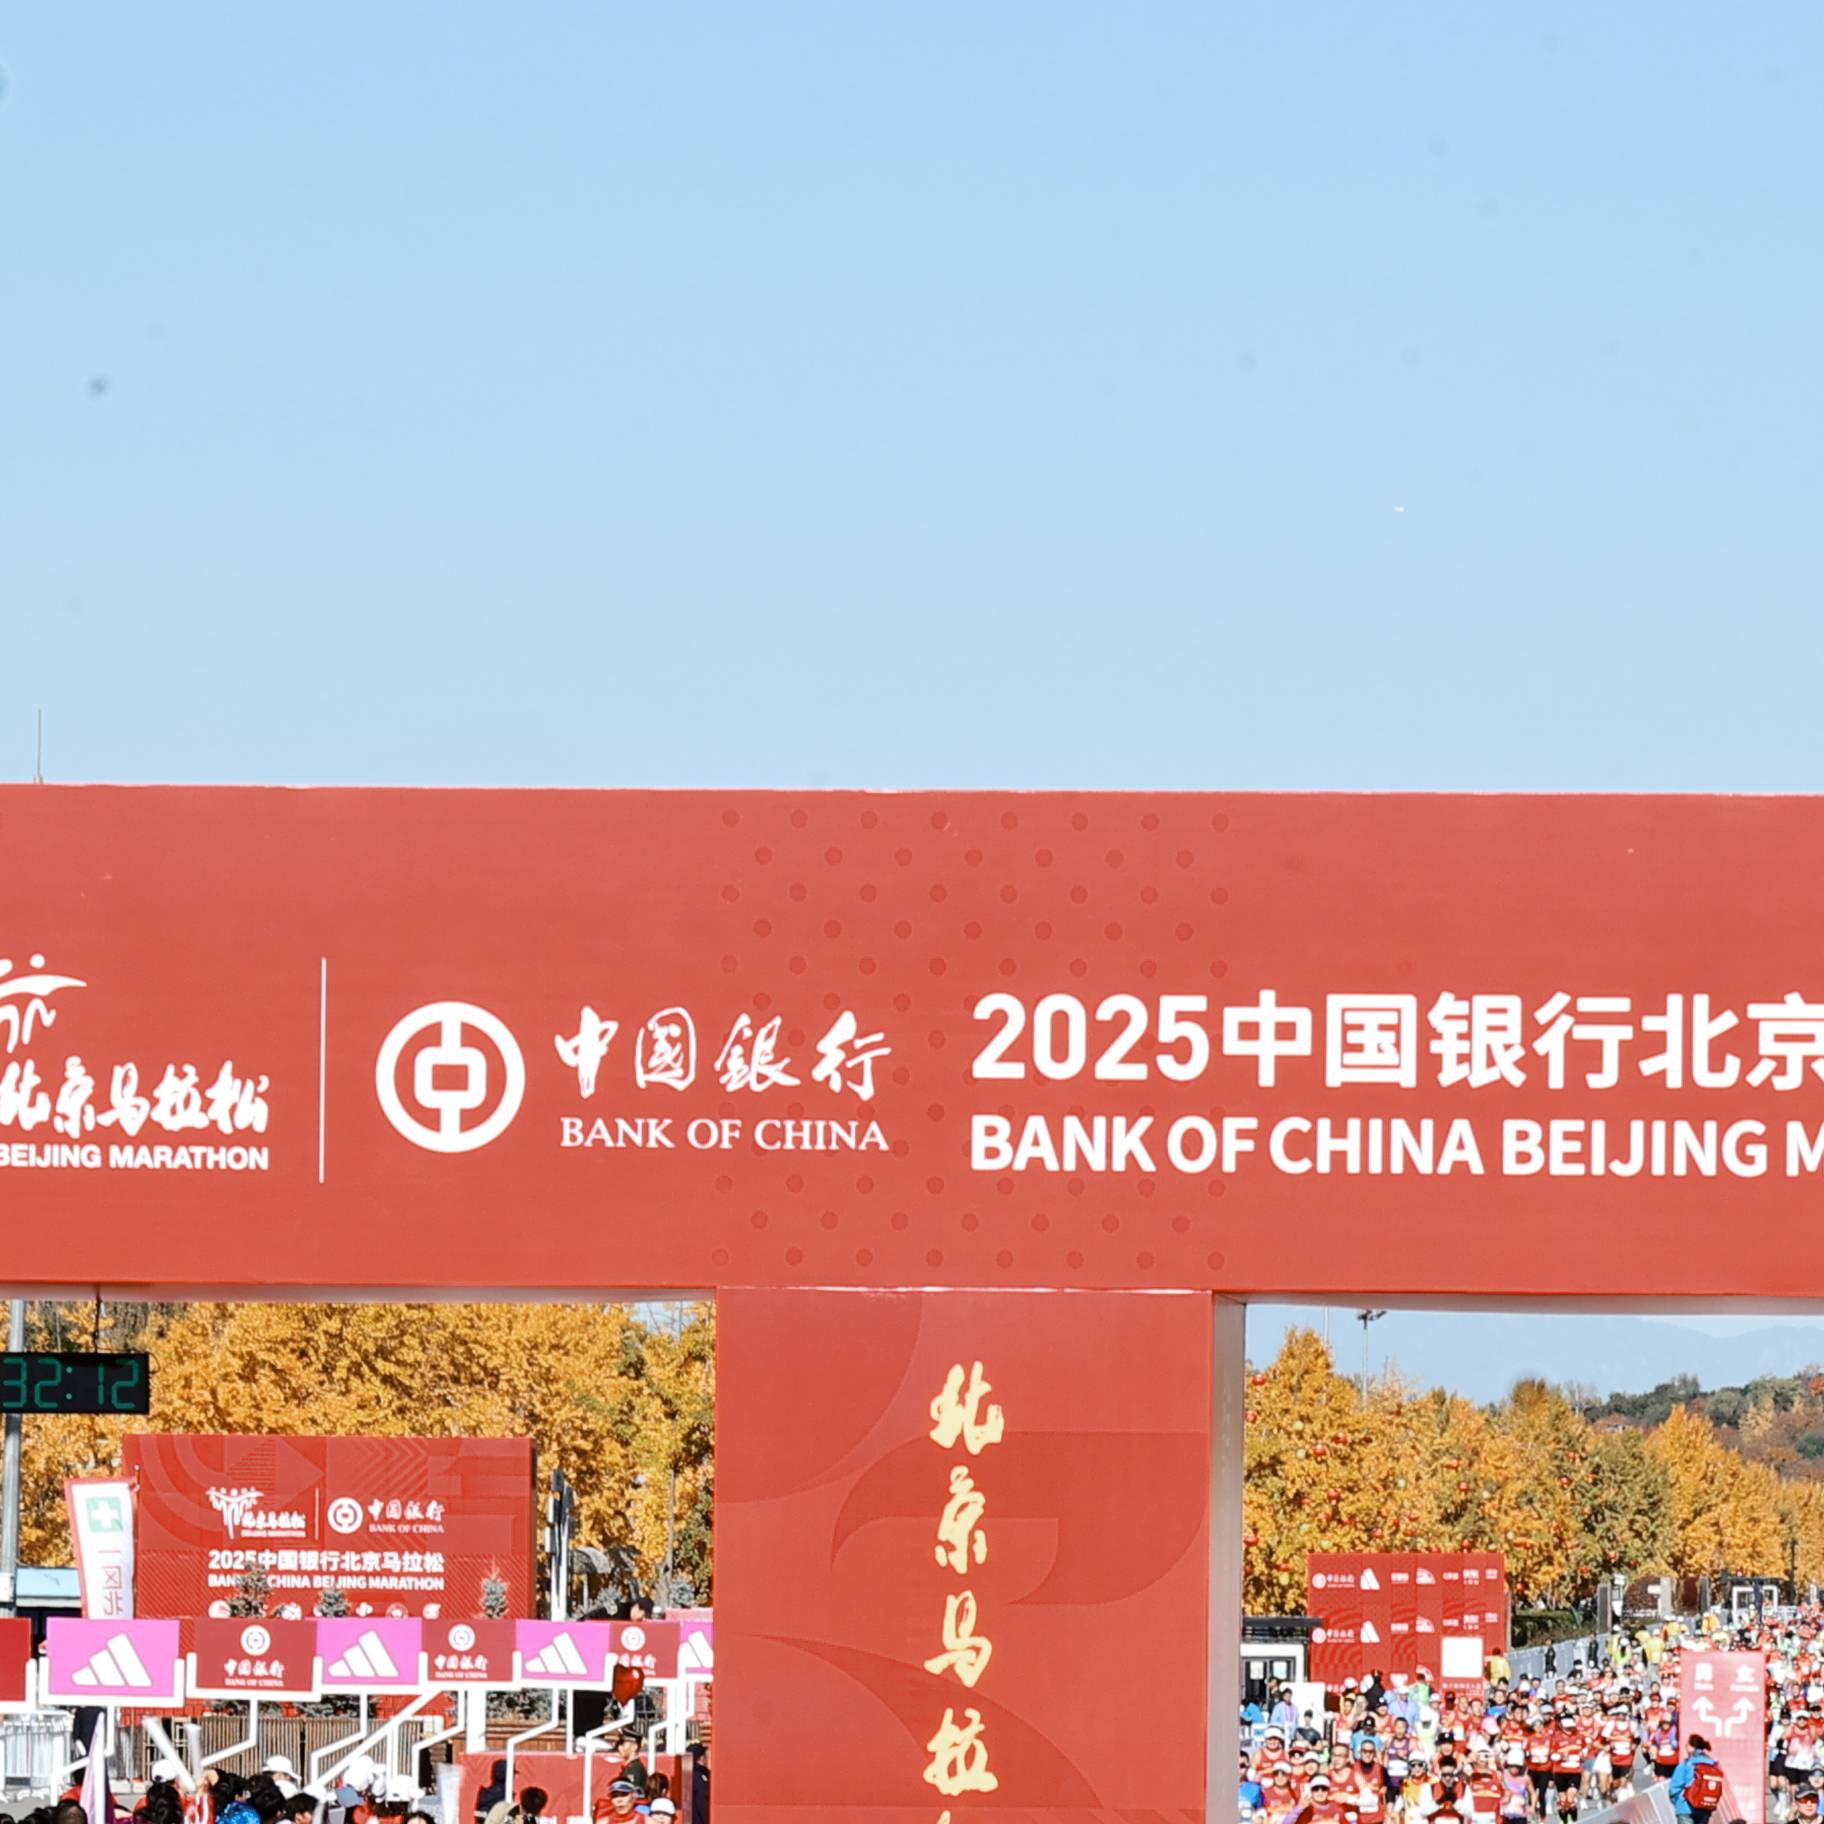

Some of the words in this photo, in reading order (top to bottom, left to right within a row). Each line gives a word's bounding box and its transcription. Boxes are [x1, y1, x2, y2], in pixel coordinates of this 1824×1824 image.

[560, 1117, 675, 1148] BANK
[687, 1118, 744, 1150] OF
[753, 1119, 891, 1152] CHINA
[971, 1114, 1157, 1172] BANK
[1166, 1115, 1259, 1173] OF
[1268, 1117, 1485, 1175] CHINA
[1501, 1119, 1768, 1177] BEIJING
[109, 1144, 270, 1171] MARATHON
[368, 1524, 396, 1533] BANK
[412, 1525, 445, 1534] CHINA
[208, 1549, 445, 1573] 2025中国银行北京马拉松
[267, 1575, 311, 1588] CHINA
[368, 1576, 445, 1591] MARATHON
